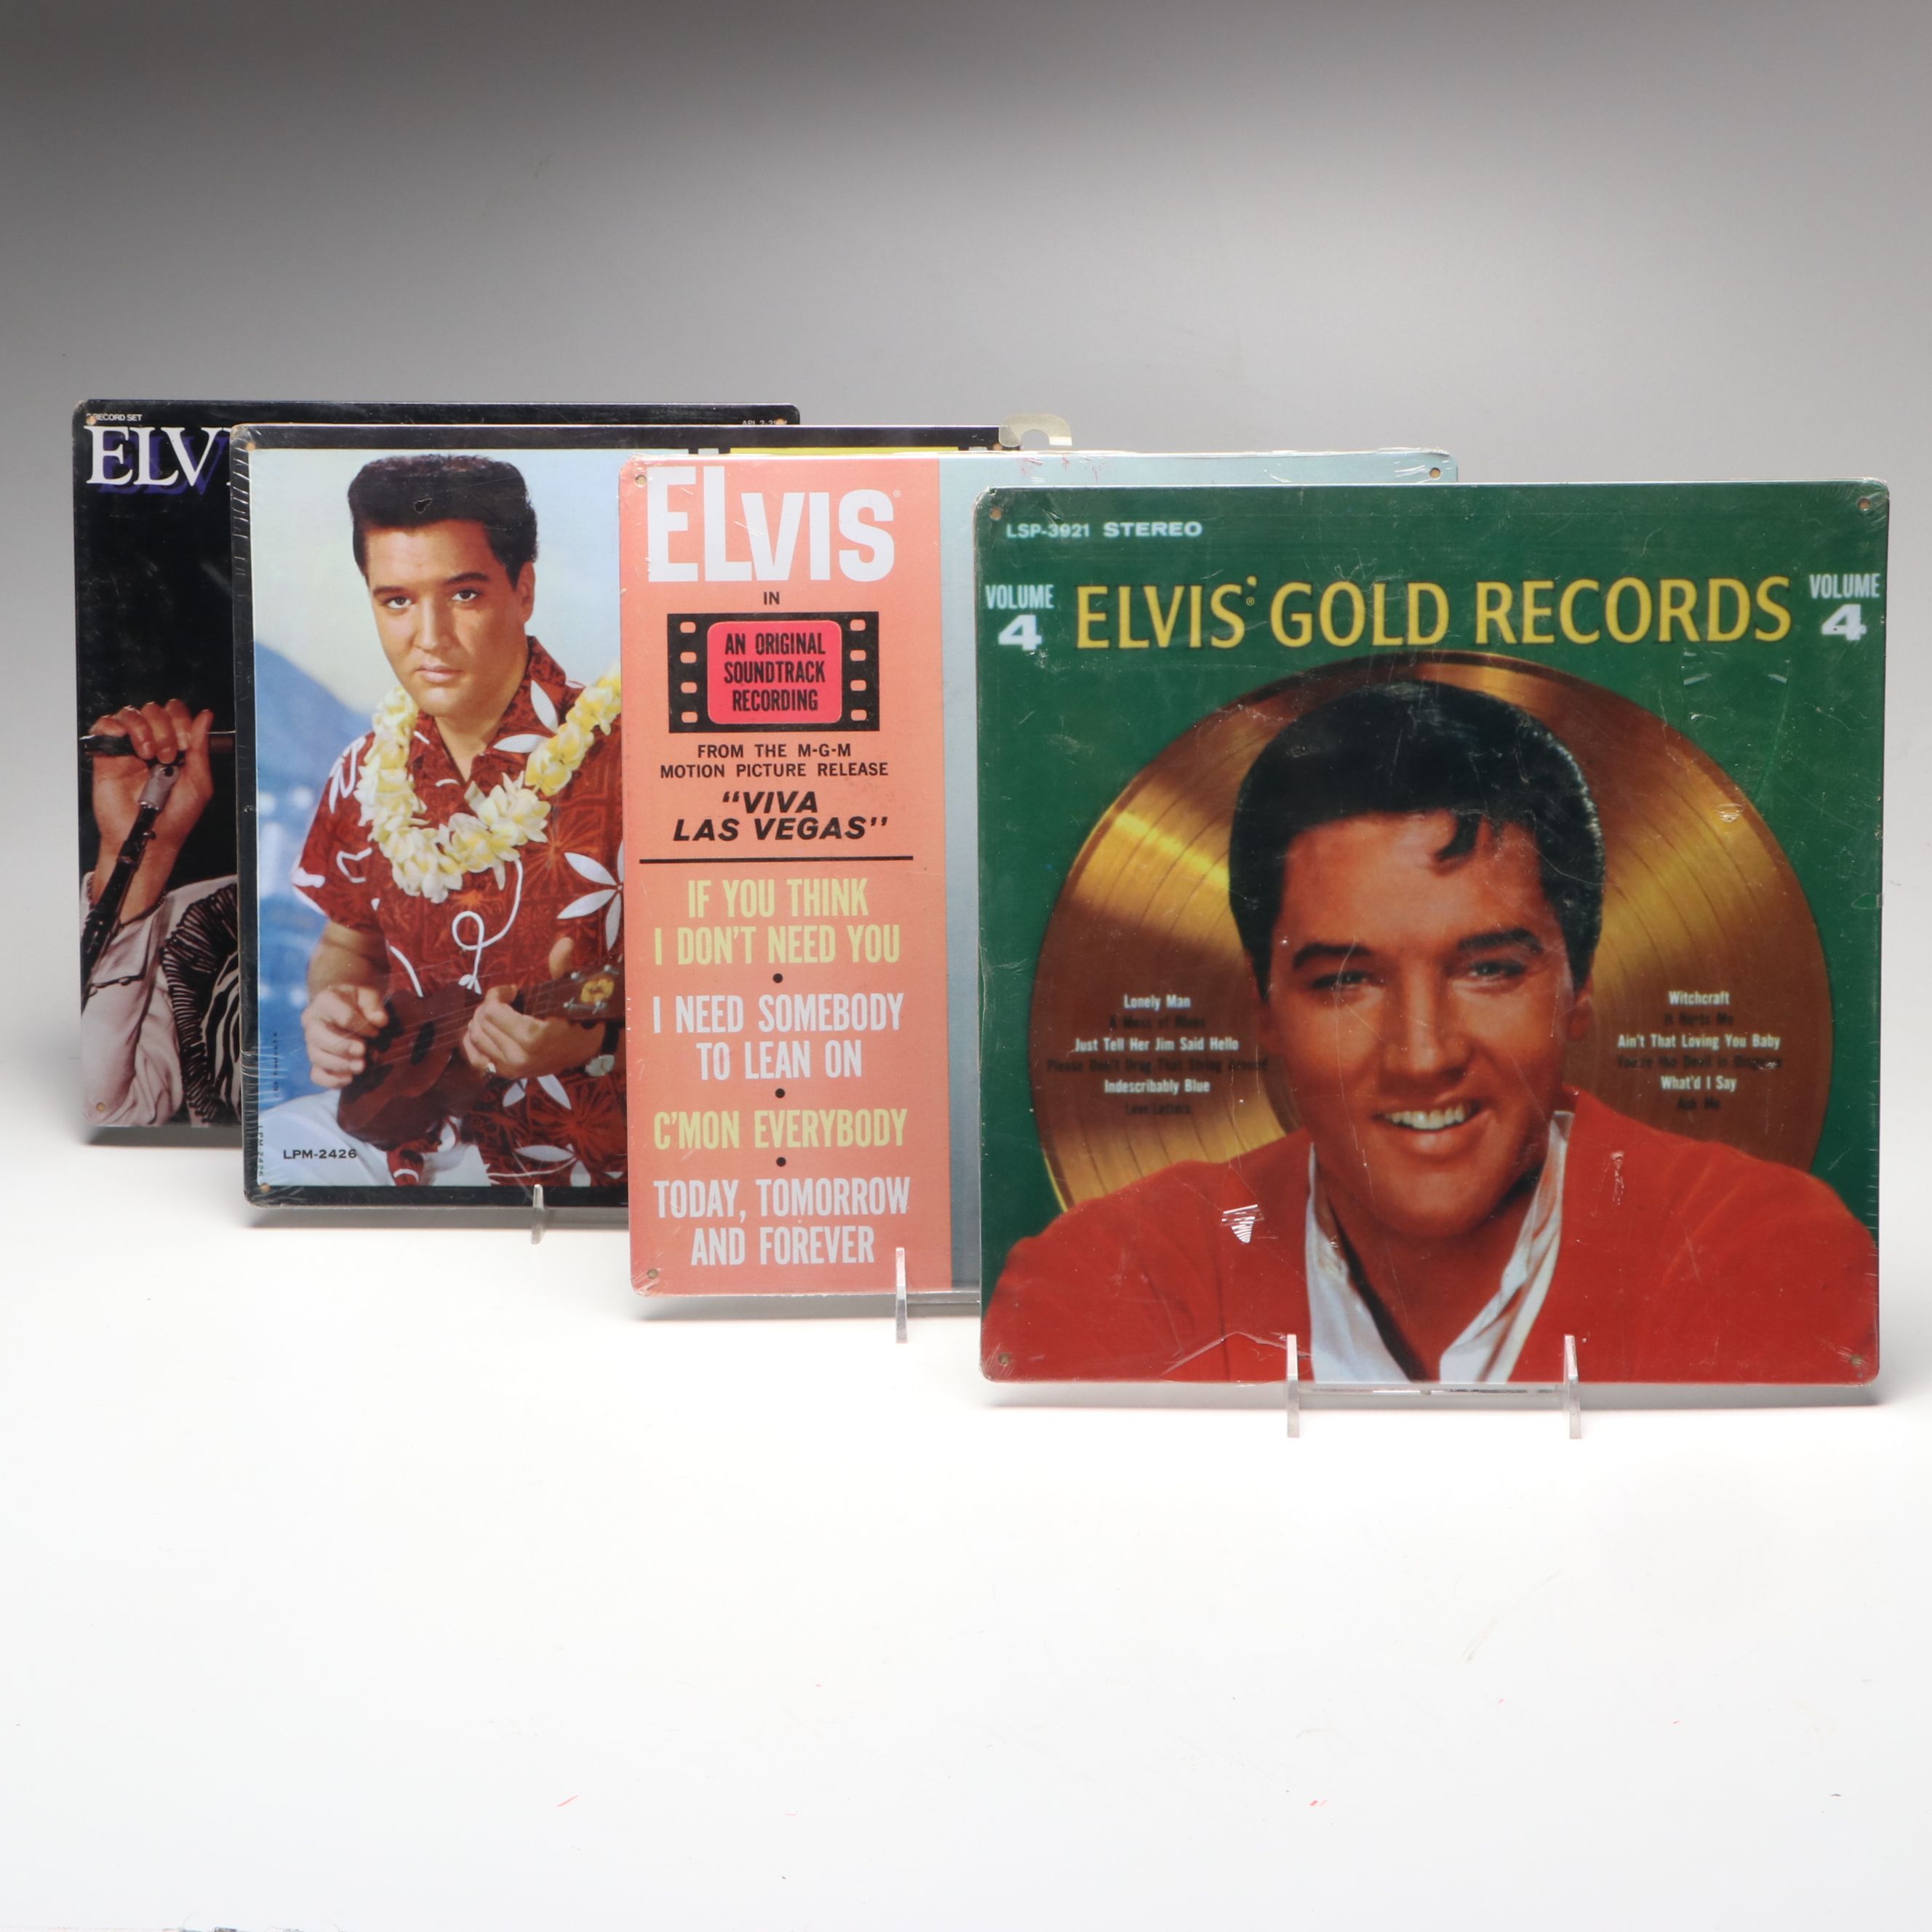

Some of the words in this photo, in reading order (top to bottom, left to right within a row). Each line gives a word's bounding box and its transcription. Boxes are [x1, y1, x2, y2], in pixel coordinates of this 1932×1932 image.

[84, 426, 233, 487] ELV
[1006, 524, 1090, 539] LSP-3921
[1103, 522, 1203, 538] STEREO
[985, 584, 1054, 610] VOLUME
[1809, 573, 1880, 599] VOLUME
[763, 591, 780, 605] IN
[1270, 580, 1450, 647] GOLD
[1475, 575, 1792, 644] RECORDS
[1820, 604, 1867, 641] 4
[724, 633, 746, 655] AN
[756, 632, 825, 655] ORIGINAL
[997, 614, 1042, 650] 4
[724, 660, 826, 684] SOUNDTRACK
[733, 690, 818, 711] RECORDING
[698, 743, 743, 758] FROM
[755, 743, 786, 757] THE
[798, 743, 851, 757] M-G-M
[660, 763, 724, 778] MOTION
[736, 762, 806, 778] PICTURE
[818, 762, 888, 777] RELEASE
[673, 819, 739, 842] LAS
[687, 880, 711, 918] IF
[722, 879, 775, 917] YOU
[786, 878, 869, 917] THINK
[654, 927, 663, 965] I
[677, 926, 757, 965] DON'T
[767, 925, 836, 964] NEED
[847, 924, 901, 962] YOU
[1124, 994, 1160, 1011] Lonely
[1166, 994, 1191, 1008] Man
[1669, 991, 1731, 1005] Witchcraft
[653, 996, 661, 1033] I
[675, 994, 743, 1033] NEED
[758, 992, 904, 1032] SOMEBODY
[1074, 1038, 1098, 1052] Just
[1103, 1038, 1124, 1051] Tell
[1130, 1038, 1150, 1051] Her
[1155, 1038, 1175, 1051] Jim
[1180, 1037, 1204, 1050] Said
[1210, 1037, 1239, 1050] Hello
[1618, 1034, 1645, 1048] Ain't
[1650, 1034, 1676, 1047] That
[1682, 1034, 1719, 1050] Loving
[1725, 1034, 1746, 1047] You
[1752, 1034, 1781, 1050] Baby
[695, 1042, 730, 1080] TO
[744, 1040, 810, 1079] LEAN
[825, 1039, 862, 1077] ON
[1104, 1079, 1179, 1095] Indescribably
[1184, 1079, 1210, 1093] Blue
[1661, 1075, 1701, 1090] What'd
[1707, 1076, 1711, 1089] I
[1715, 1075, 1737, 1093] Say
[654, 1111, 740, 1149] C'MON
[754, 1108, 908, 1148] EVERYBODY
[284, 1149, 357, 1159] LPM-2426
[653, 1179, 747, 1223] TODAY,
[755, 1176, 911, 1218] TOMORROW
[691, 1227, 746, 1266] AND
[759, 1225, 874, 1264] FOREVER
